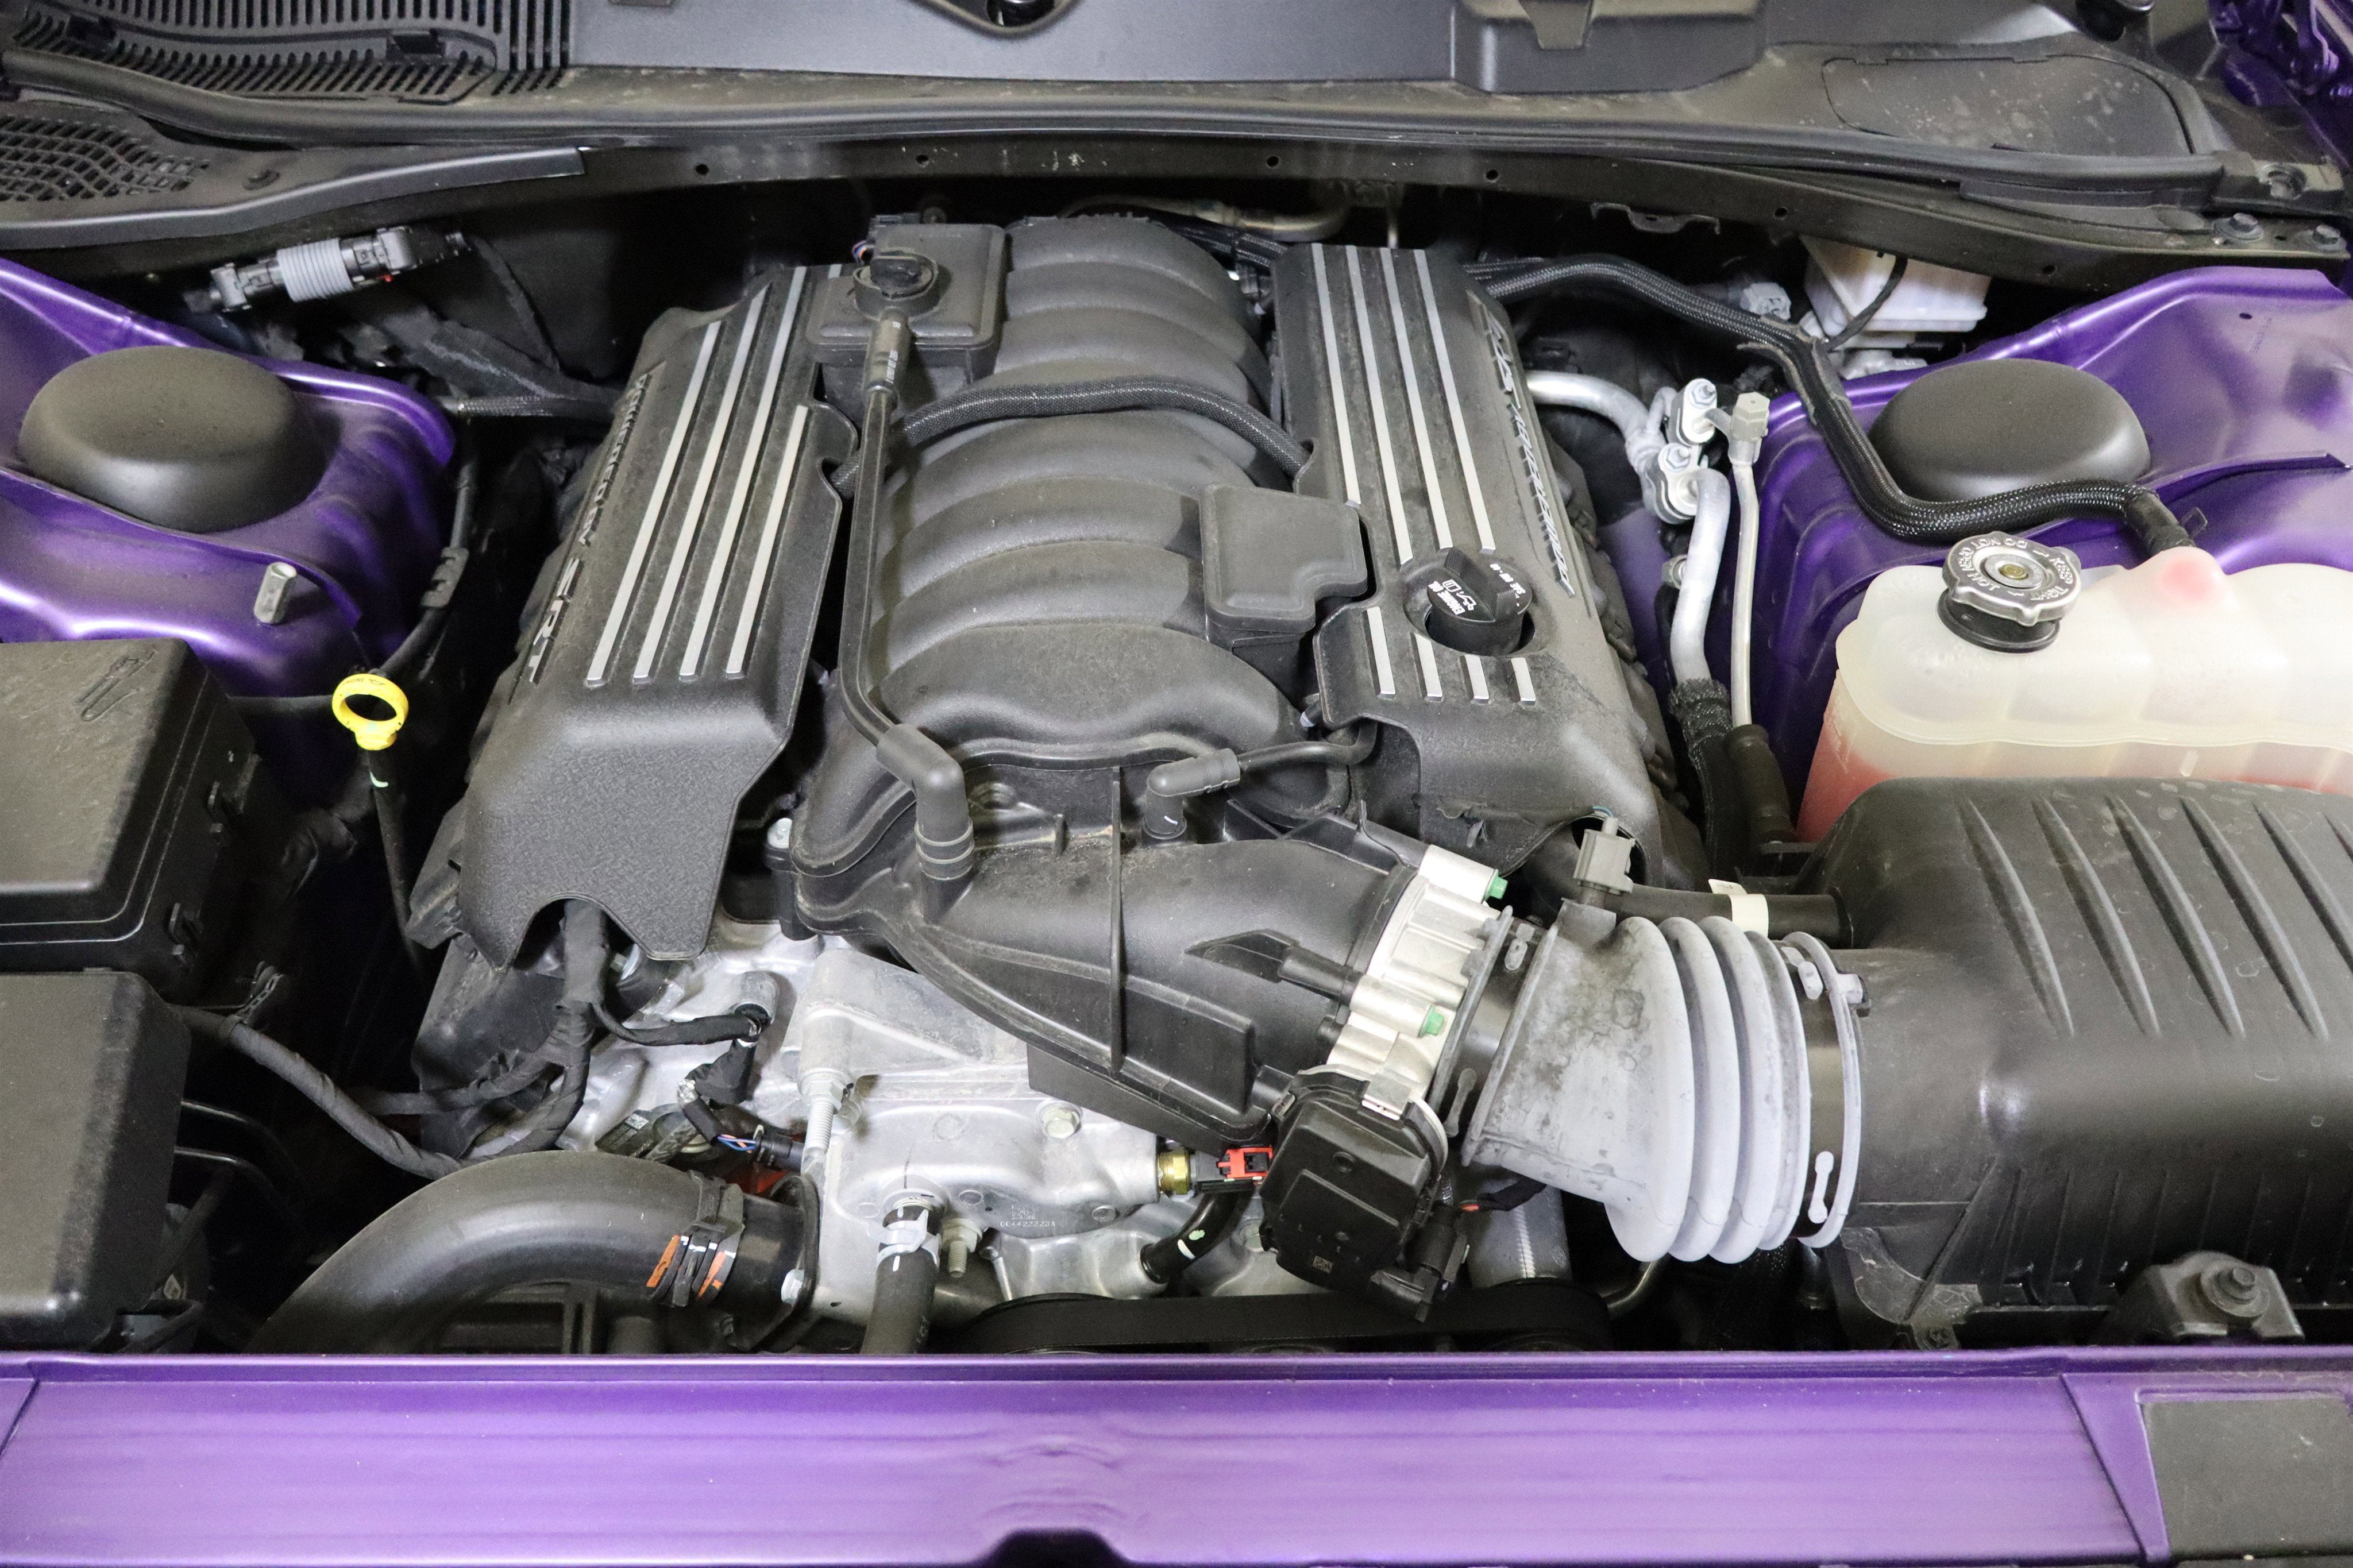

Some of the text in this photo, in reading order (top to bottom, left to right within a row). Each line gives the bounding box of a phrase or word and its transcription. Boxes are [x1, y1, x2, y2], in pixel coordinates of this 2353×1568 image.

[1482, 305, 1575, 597] POWERED BY SRT
[529, 373, 650, 684] POWERED BY SRT
[1970, 538, 2001, 550] NOT
[2004, 538, 2027, 549] DO
[1958, 547, 1974, 571] OPEN
[1509, 582, 1526, 595] SAE
[1967, 570, 2000, 592] HOT
[2030, 558, 2074, 601] KEEP TIGHT
[1428, 581, 1465, 615] ENGINE OIL
